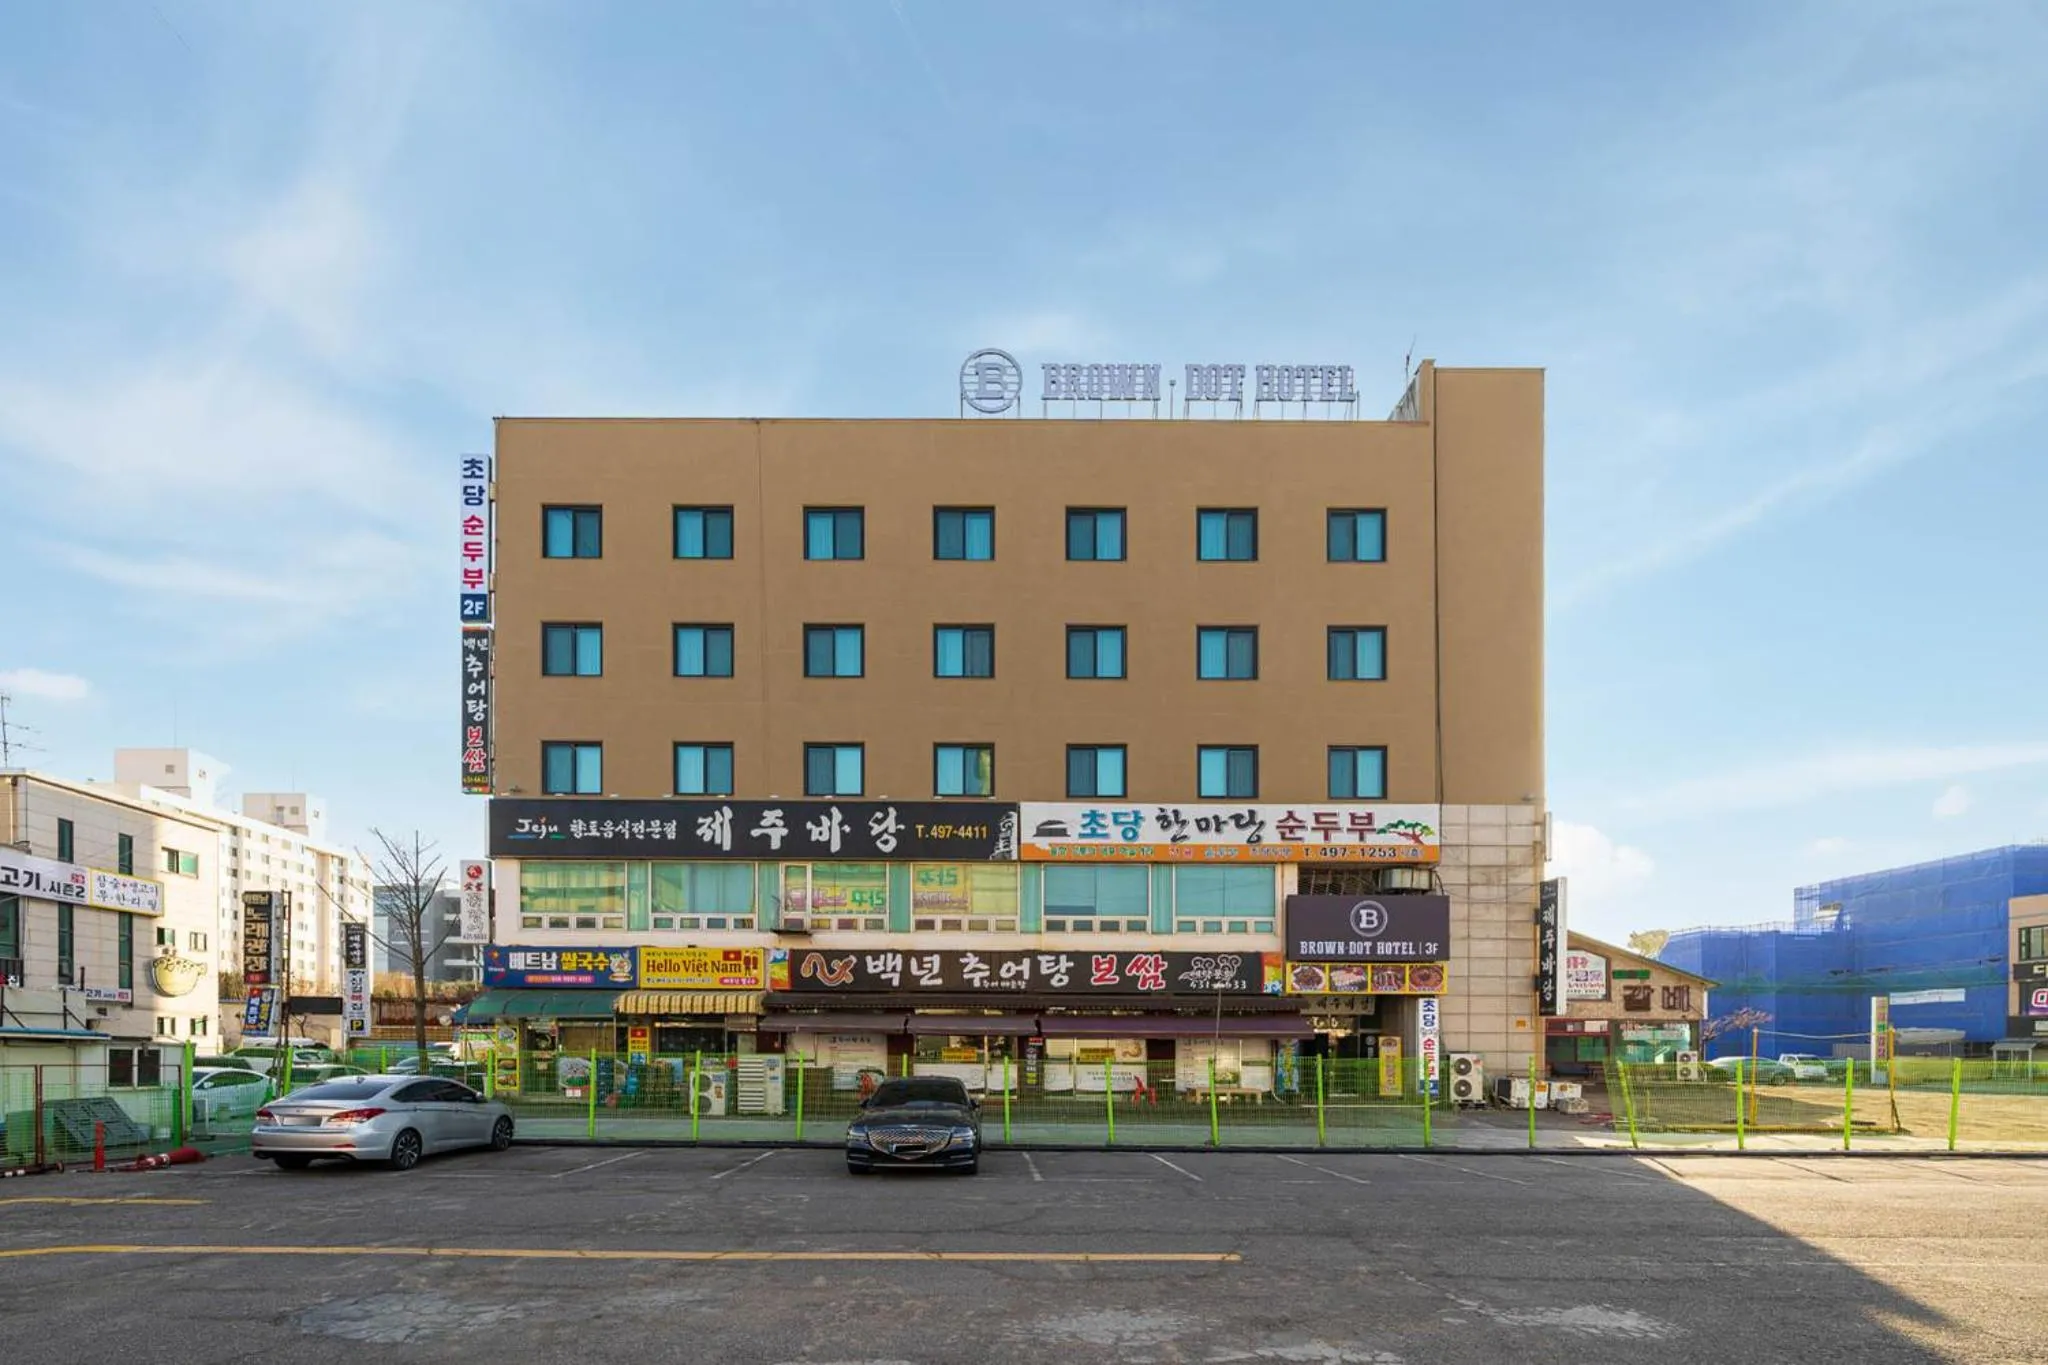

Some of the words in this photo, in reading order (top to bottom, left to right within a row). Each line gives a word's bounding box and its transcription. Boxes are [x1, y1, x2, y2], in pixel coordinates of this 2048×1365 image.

[1042, 364, 1161, 400] BROWN
[1256, 365, 1356, 401] HOTEL
[462, 457, 485, 506] 초당
[462, 514, 485, 590] 순두부
[463, 599, 486, 616] 2F
[463, 638, 489, 651] 백년
[465, 654, 488, 722] 추어탕
[463, 726, 486, 773] 보쌈
[515, 815, 559, 840] Jeju
[1078, 808, 1146, 842] 초당
[1155, 806, 1266, 845] 한마당
[1275, 809, 1378, 843] 순두부
[508, 951, 558, 971] 베트남
[560, 951, 610, 971] 쌀국수
[1376, 941, 1417, 956] HOTEL
[1424, 942, 1440, 956] 3F
[646, 959, 681, 973] Hello
[711, 959, 742, 973] Nam
[865, 952, 943, 988] 백년
[959, 952, 1075, 988] 추어탕
[1090, 953, 1169, 990] 보쌈
[1422, 1000, 1436, 1027] 초당
